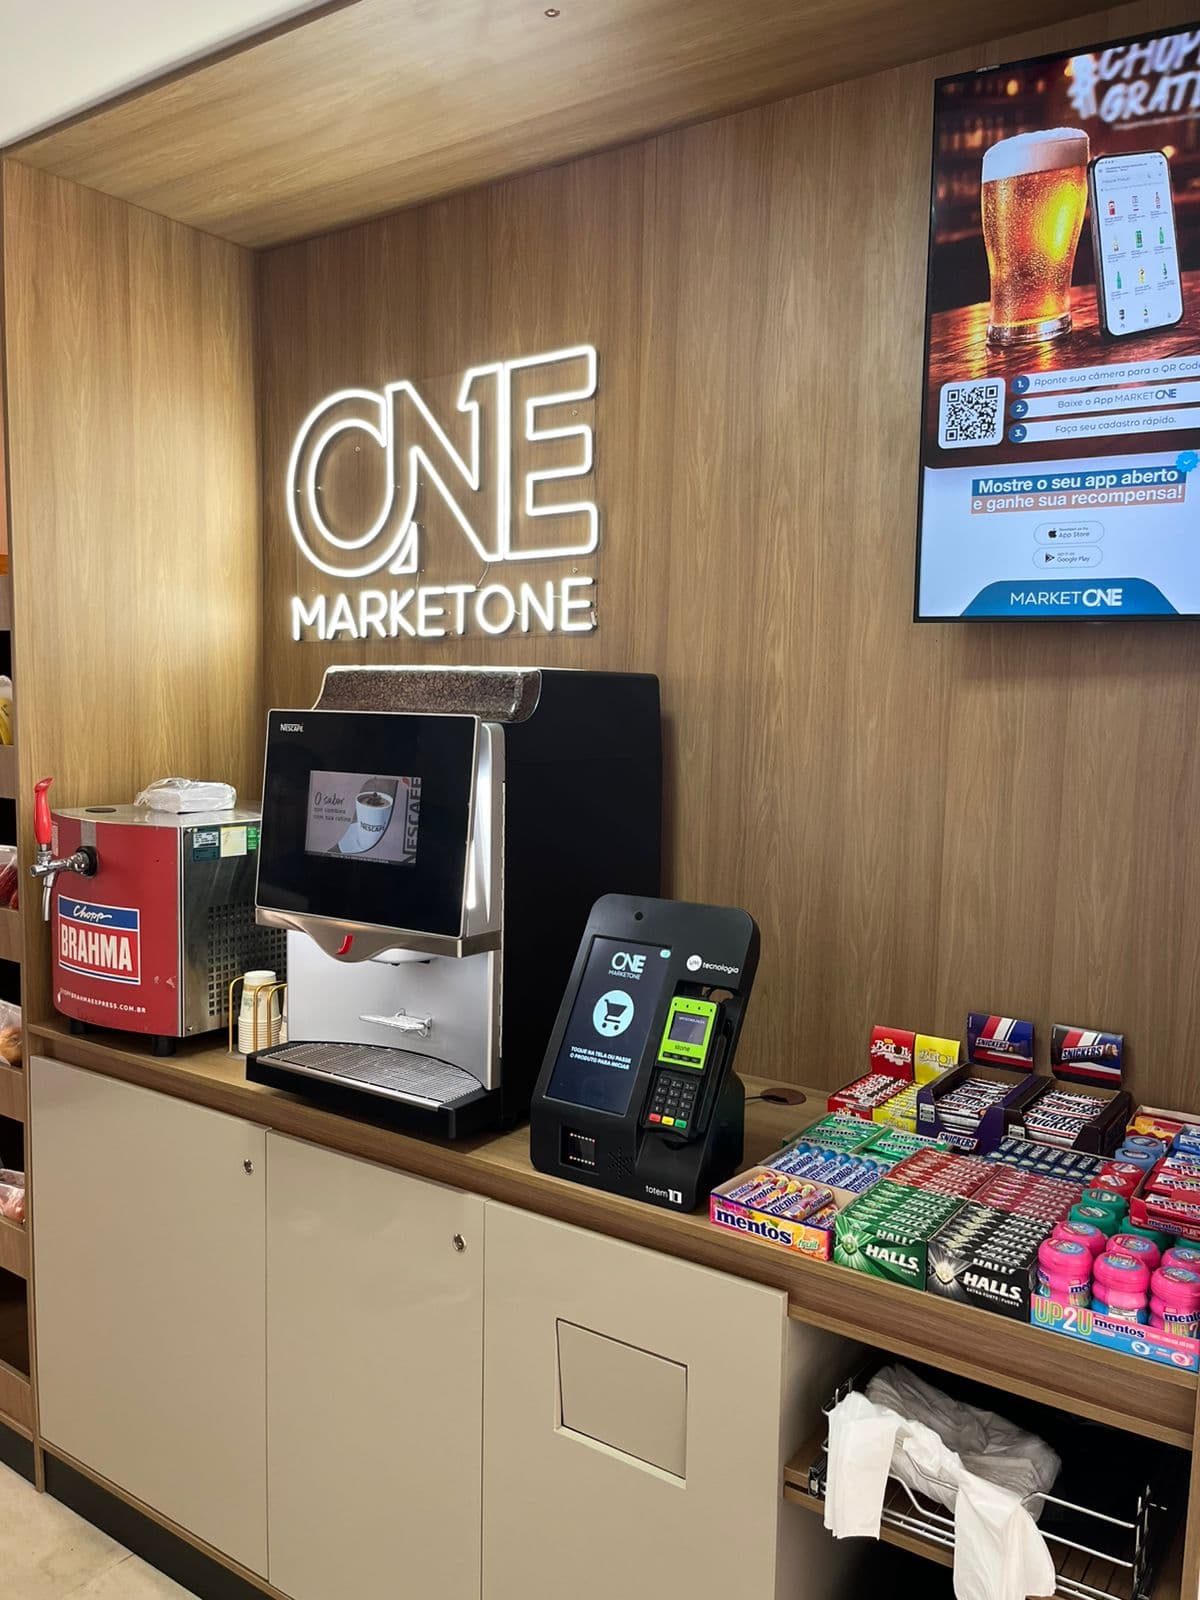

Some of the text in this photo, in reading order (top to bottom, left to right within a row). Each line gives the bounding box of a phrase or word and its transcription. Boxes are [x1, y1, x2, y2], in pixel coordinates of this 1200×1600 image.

[1100, 30, 1200, 80] CHOP
[1034, 375, 1068, 386] Aponte
[1069, 374, 1086, 383] sua
[1088, 370, 1125, 381] câmera
[1127, 368, 1150, 379] para
[1161, 363, 1177, 374] QR
[1058, 398, 1083, 409] Baixe
[1094, 396, 1113, 406] App
[1055, 422, 1078, 434] Faça
[1080, 423, 1096, 431] seu
[1098, 418, 1140, 429] cadastro
[1142, 414, 1177, 426] rápido.
[286, 345, 598, 578] ONE
[979, 468, 1178, 494] Mostre o seu app aberto
[973, 485, 1183, 512] e ganhe sua recompensa!
[291, 577, 596, 641] MARKETONE
[73, 905, 113, 923] Chopp
[61, 923, 133, 972] BRAHMA
[612, 951, 647, 974] ONE
[702, 961, 740, 975] tecnologia
[976, 1038, 1009, 1050] SNICKERS
[1062, 1046, 1103, 1060] SNICKERS
[939, 1132, 977, 1149] SNICKERS
[645, 1185, 669, 1198] totem
[716, 1208, 792, 1245] mentos
[866, 1244, 920, 1271] HALLS
[963, 1271, 1022, 1300] HALLS
[1034, 1297, 1093, 1336] UP2U
[1093, 1318, 1145, 1339] mentos
